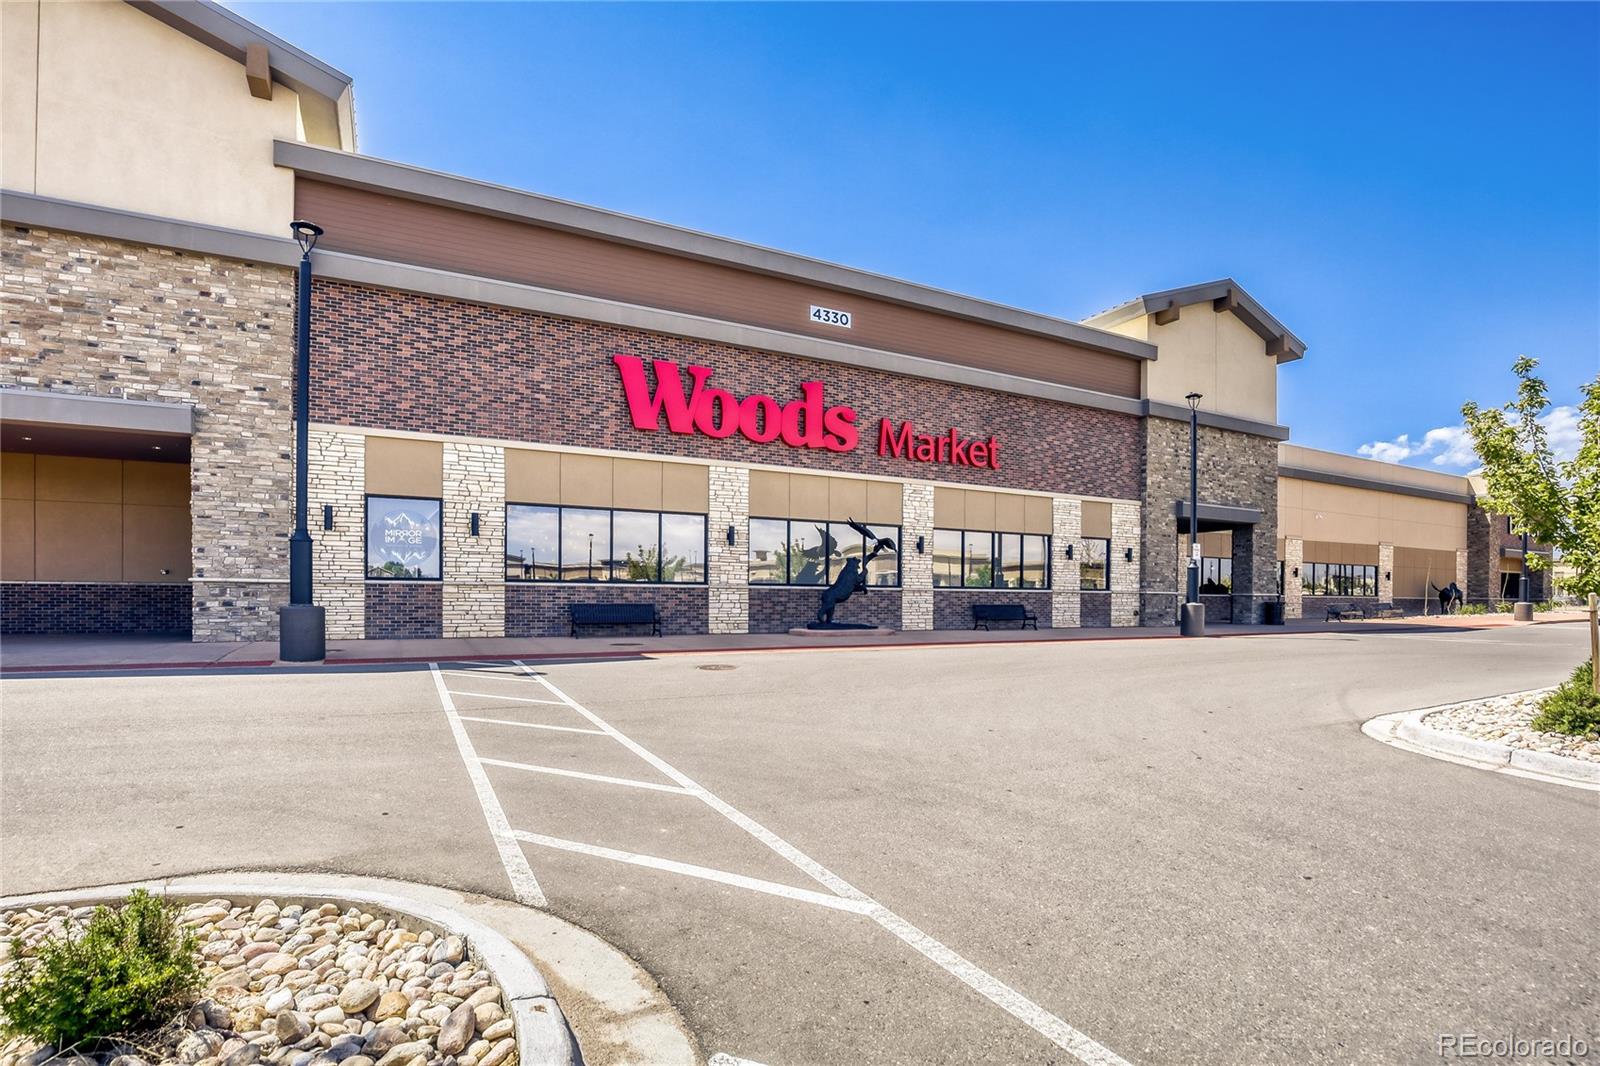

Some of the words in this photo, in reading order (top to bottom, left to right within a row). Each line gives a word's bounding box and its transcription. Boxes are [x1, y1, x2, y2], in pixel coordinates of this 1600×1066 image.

[813, 308, 849, 326] 4330
[613, 354, 858, 453] Woods
[878, 417, 1001, 470] Market
[384, 529, 422, 537] MIRROR
